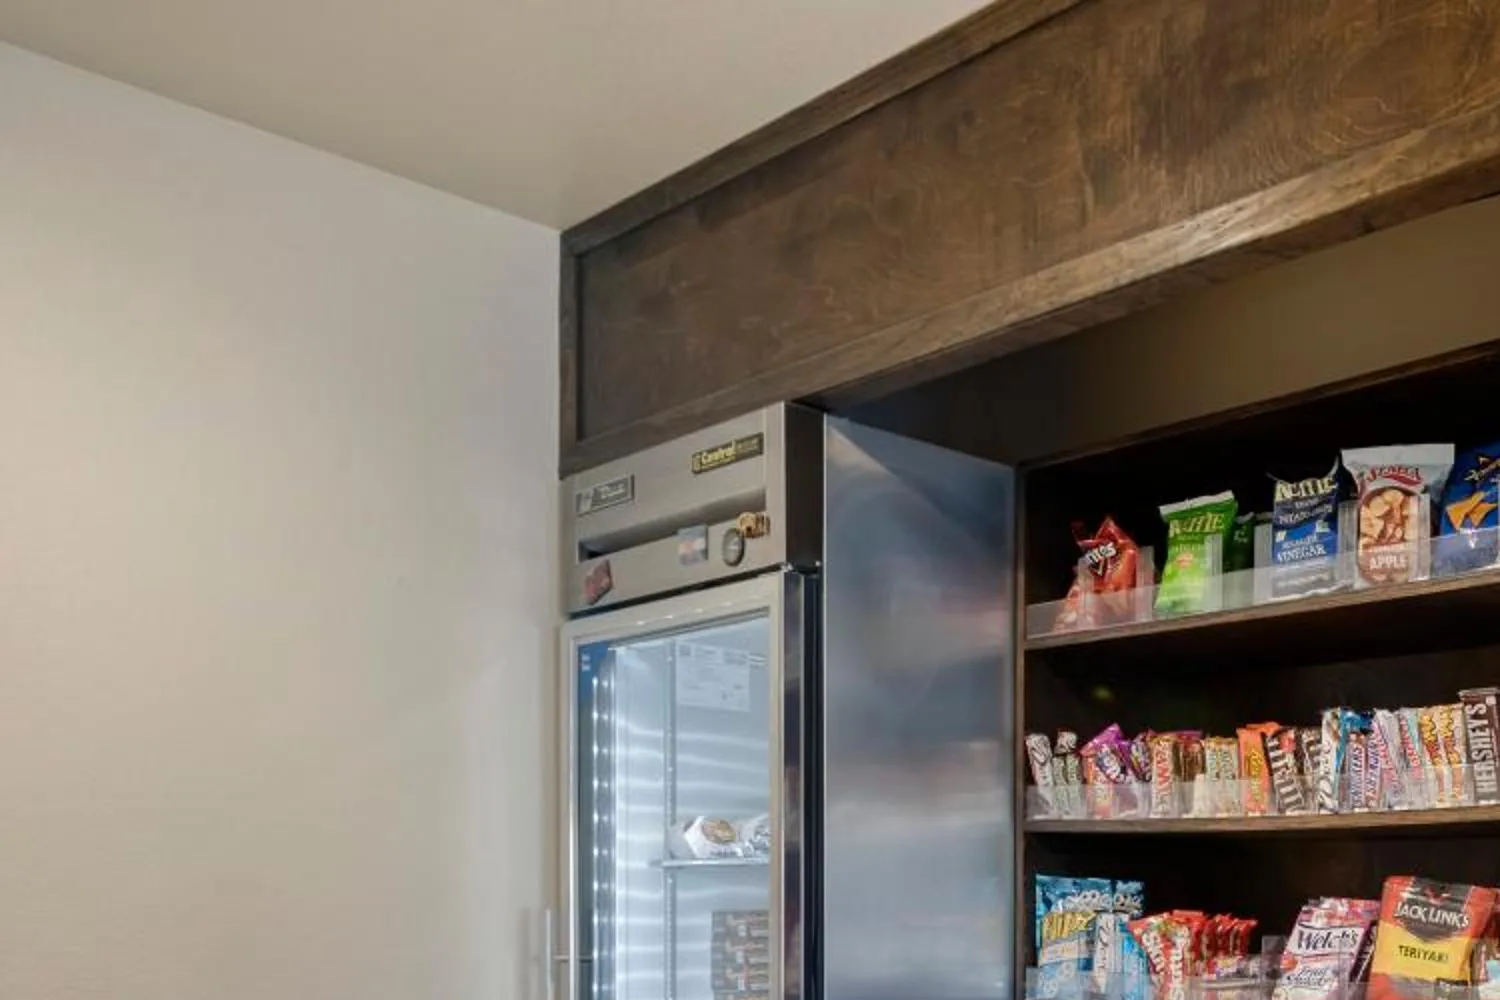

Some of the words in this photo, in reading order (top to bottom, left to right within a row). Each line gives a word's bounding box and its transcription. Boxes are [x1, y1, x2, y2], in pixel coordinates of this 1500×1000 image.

[1369, 554, 1407, 570] APPLE
[1465, 702, 1498, 793] HERSHEY'S
[1394, 902, 1428, 923] JACK
[1297, 928, 1359, 951] Welch's
